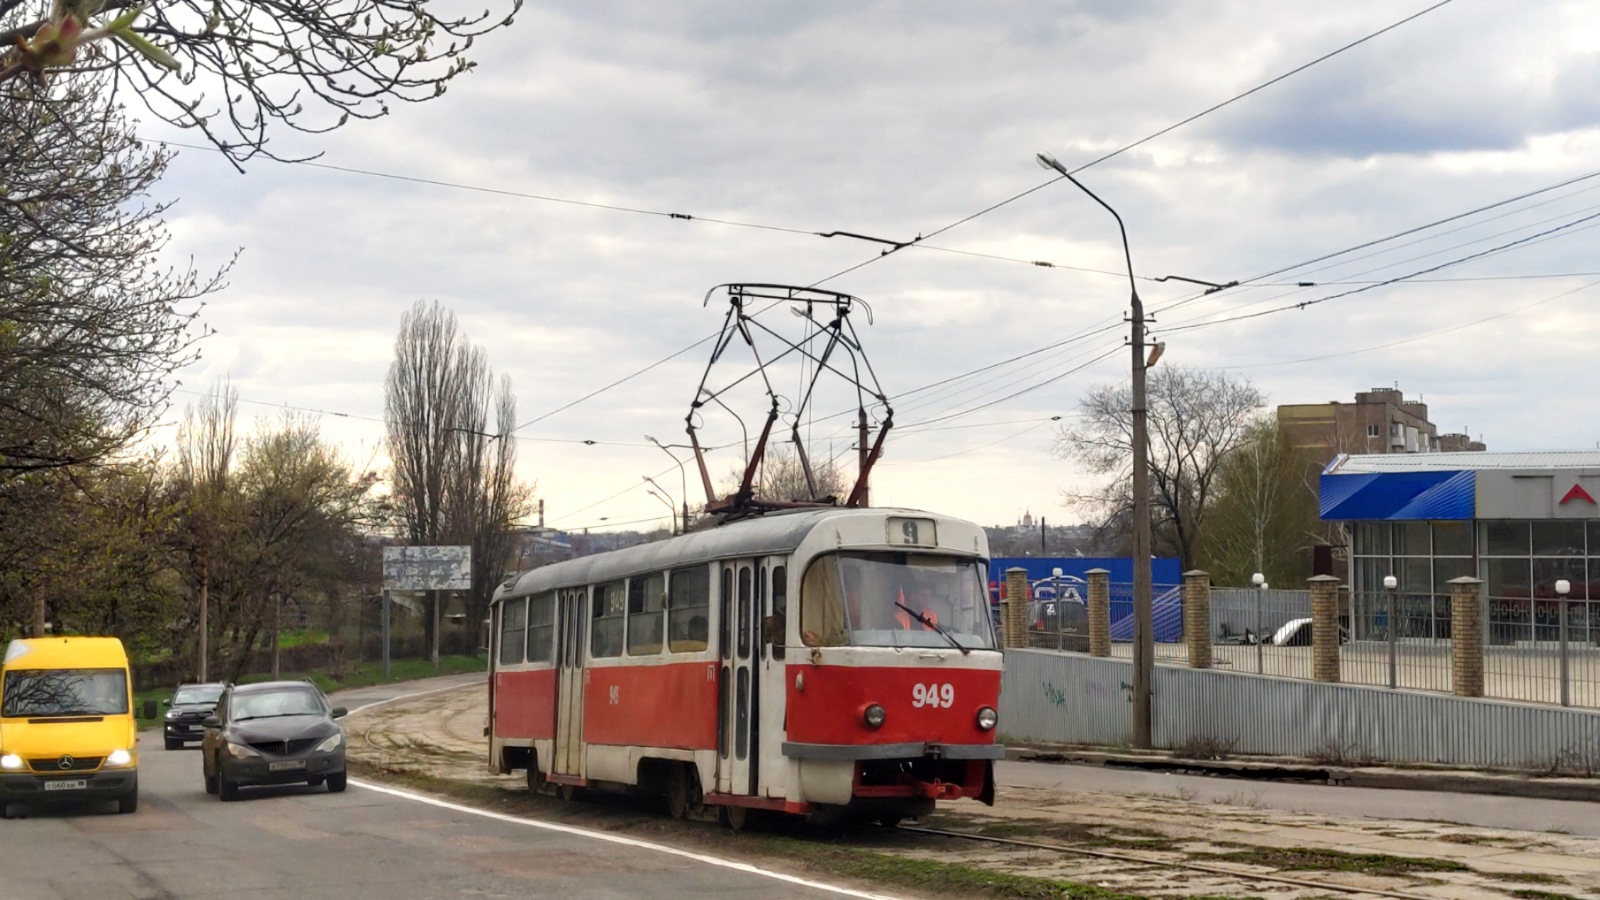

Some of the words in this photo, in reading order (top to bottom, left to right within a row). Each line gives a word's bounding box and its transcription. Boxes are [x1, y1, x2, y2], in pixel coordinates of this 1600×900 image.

[902, 521, 918, 544] 9
[610, 590, 624, 613] 949
[912, 683, 954, 708] 949
